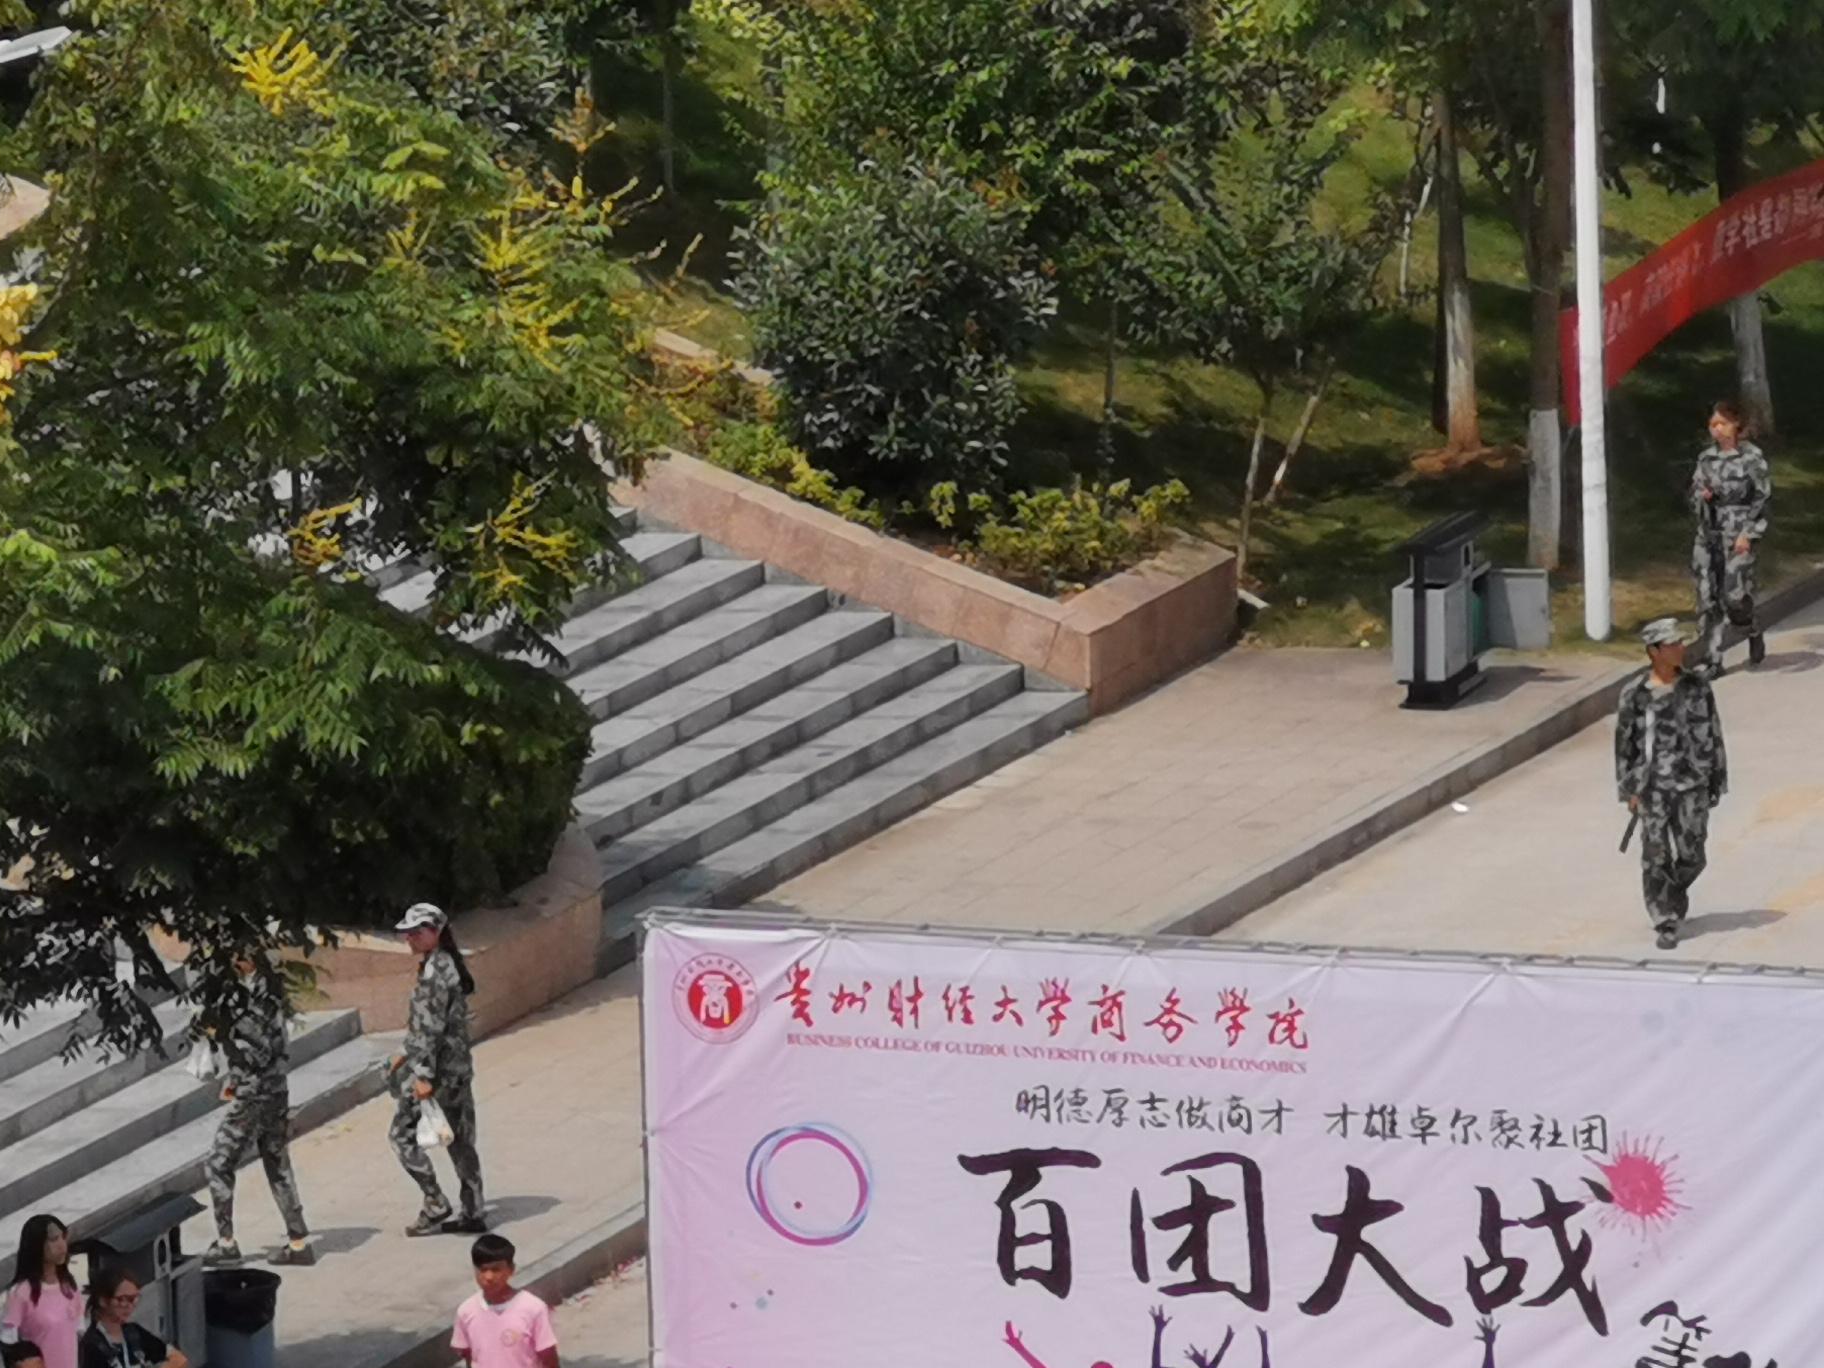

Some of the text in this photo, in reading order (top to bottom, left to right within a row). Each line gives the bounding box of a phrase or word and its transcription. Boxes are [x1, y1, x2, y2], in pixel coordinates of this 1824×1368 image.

[786, 1032, 1307, 1075] BUSINESS COLLEGE OF GUIZHOU UNIVERSITY OF FINANCE AND ECONOMICS
[957, 1146, 1615, 1337] 百团大战
